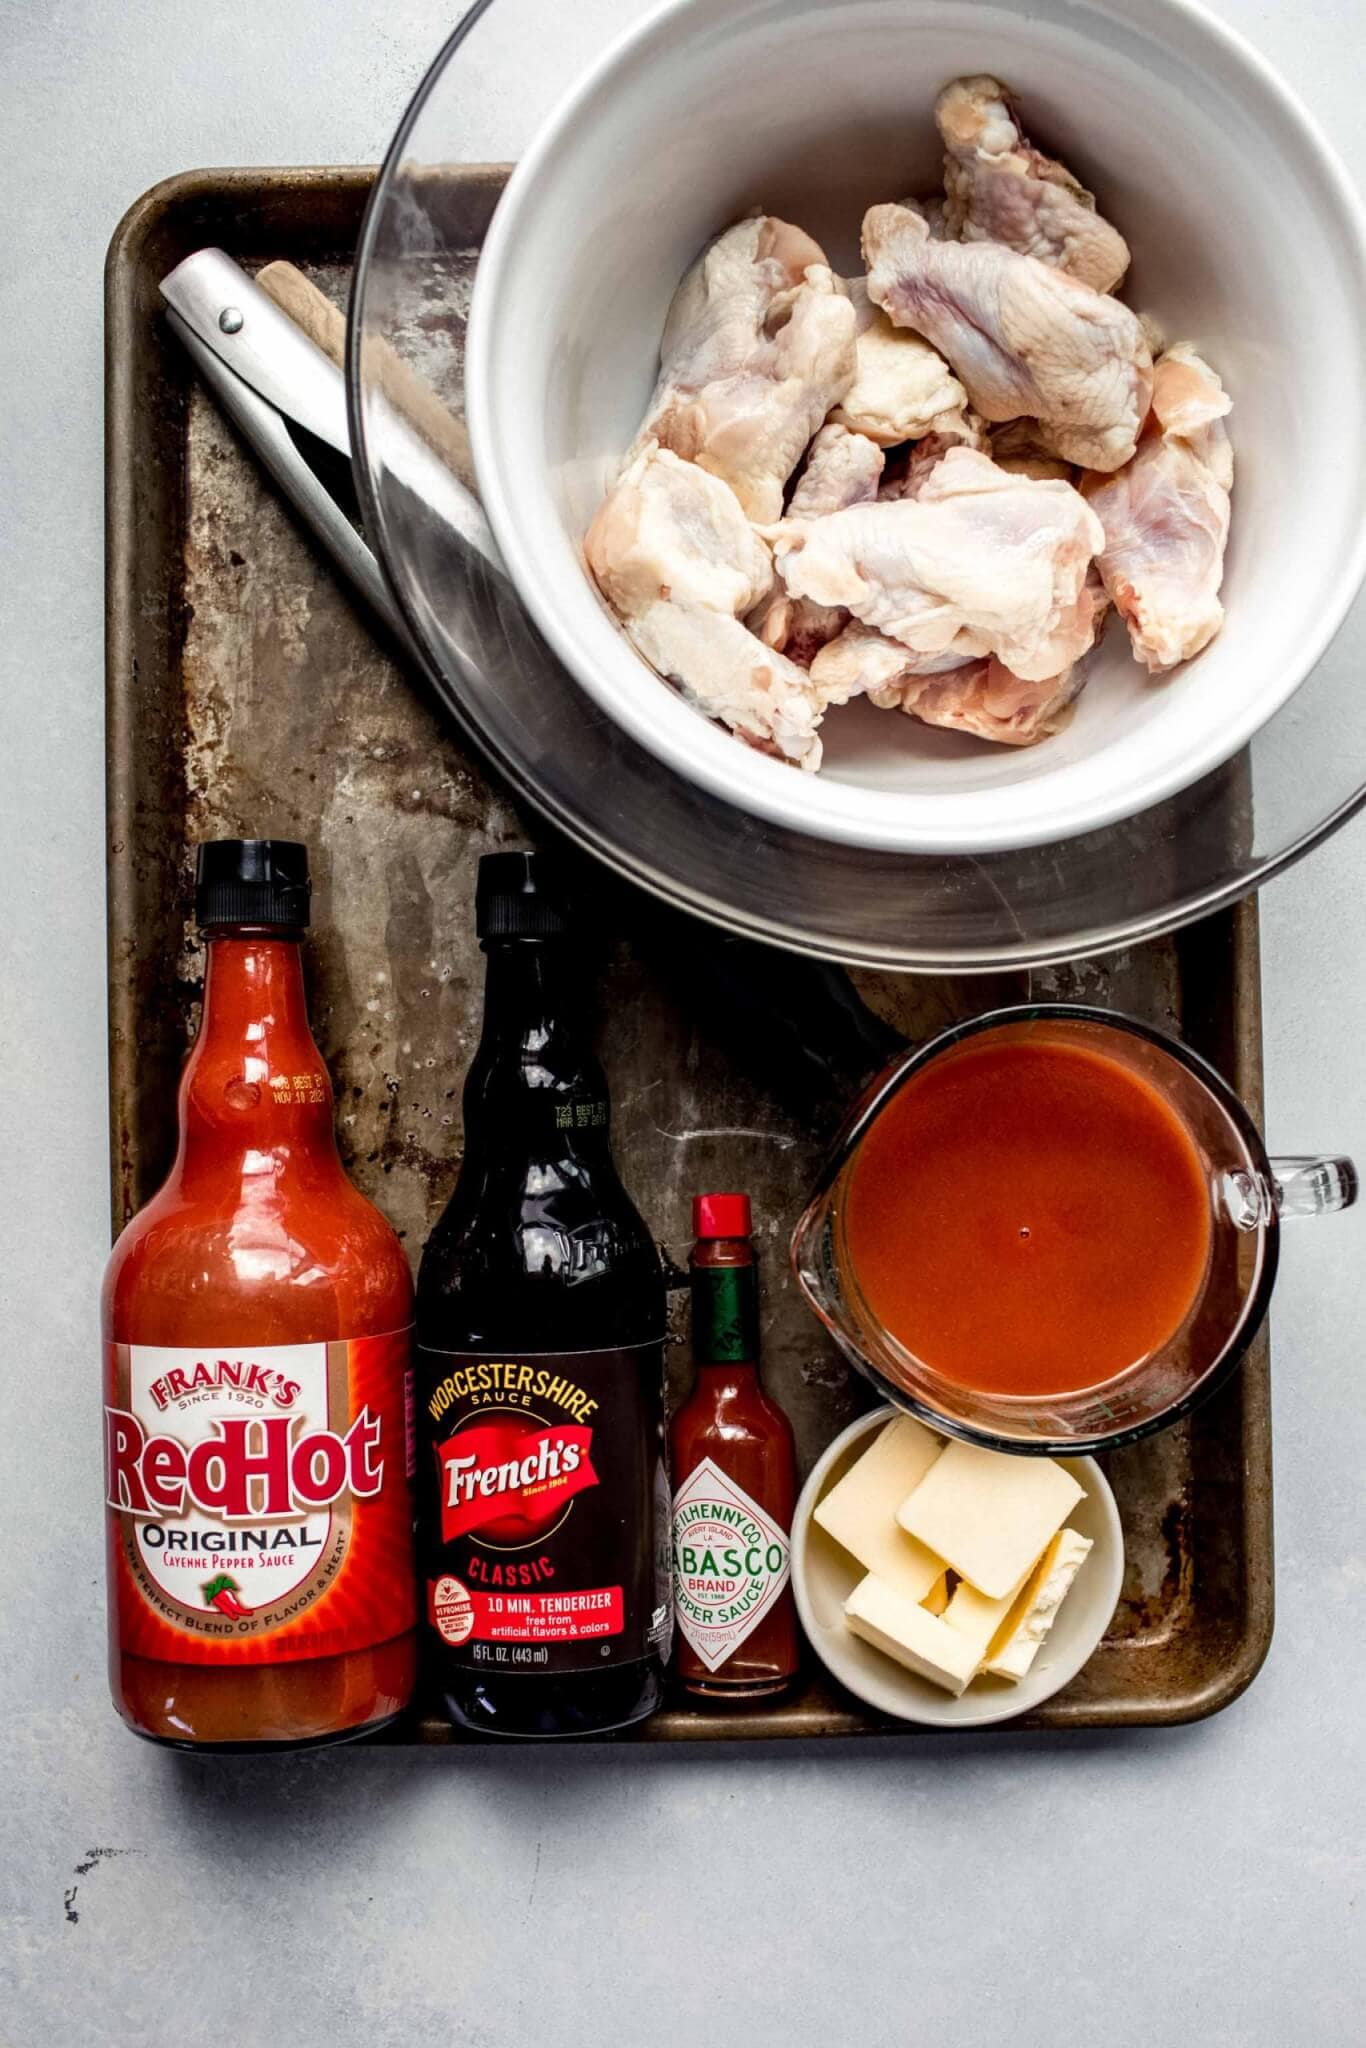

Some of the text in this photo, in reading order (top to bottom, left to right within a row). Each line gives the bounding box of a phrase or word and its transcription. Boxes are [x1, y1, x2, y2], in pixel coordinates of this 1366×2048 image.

[272, 1090, 292, 1104] NOV
[576, 1104, 595, 1116] BEST
[150, 1360, 301, 1409] FRANK'S
[428, 1363, 599, 1424] WORCESTERSHIRE
[178, 1391, 265, 1410] SINCE 1920
[471, 1391, 532, 1407] SAUCE
[104, 1404, 384, 1518] RedHot
[444, 1438, 581, 1508] French's
[522, 1485, 548, 1497] Since
[142, 1523, 323, 1552] ORIGINAL
[162, 1551, 296, 1569] CAYENNE PEPPER SAUCE
[672, 1544, 783, 1577] ABASCO
[467, 1556, 556, 1587] CLASSIC
[688, 1578, 736, 1593] BRAND
[137, 1572, 182, 1622] PERFECT
[184, 1616, 234, 1634] BLEND
[238, 1620, 259, 1633] OF
[262, 1588, 317, 1626] FLAVOR
[488, 1592, 613, 1614] 10 MIN. TENDERIZER
[717, 1578, 765, 1623] SAUCE
[491, 1622, 610, 1636] artificial flavors & colors
[525, 1615, 572, 1626] free from
[472, 1644, 549, 1665] 15 FL. OZ. (443 ml)
